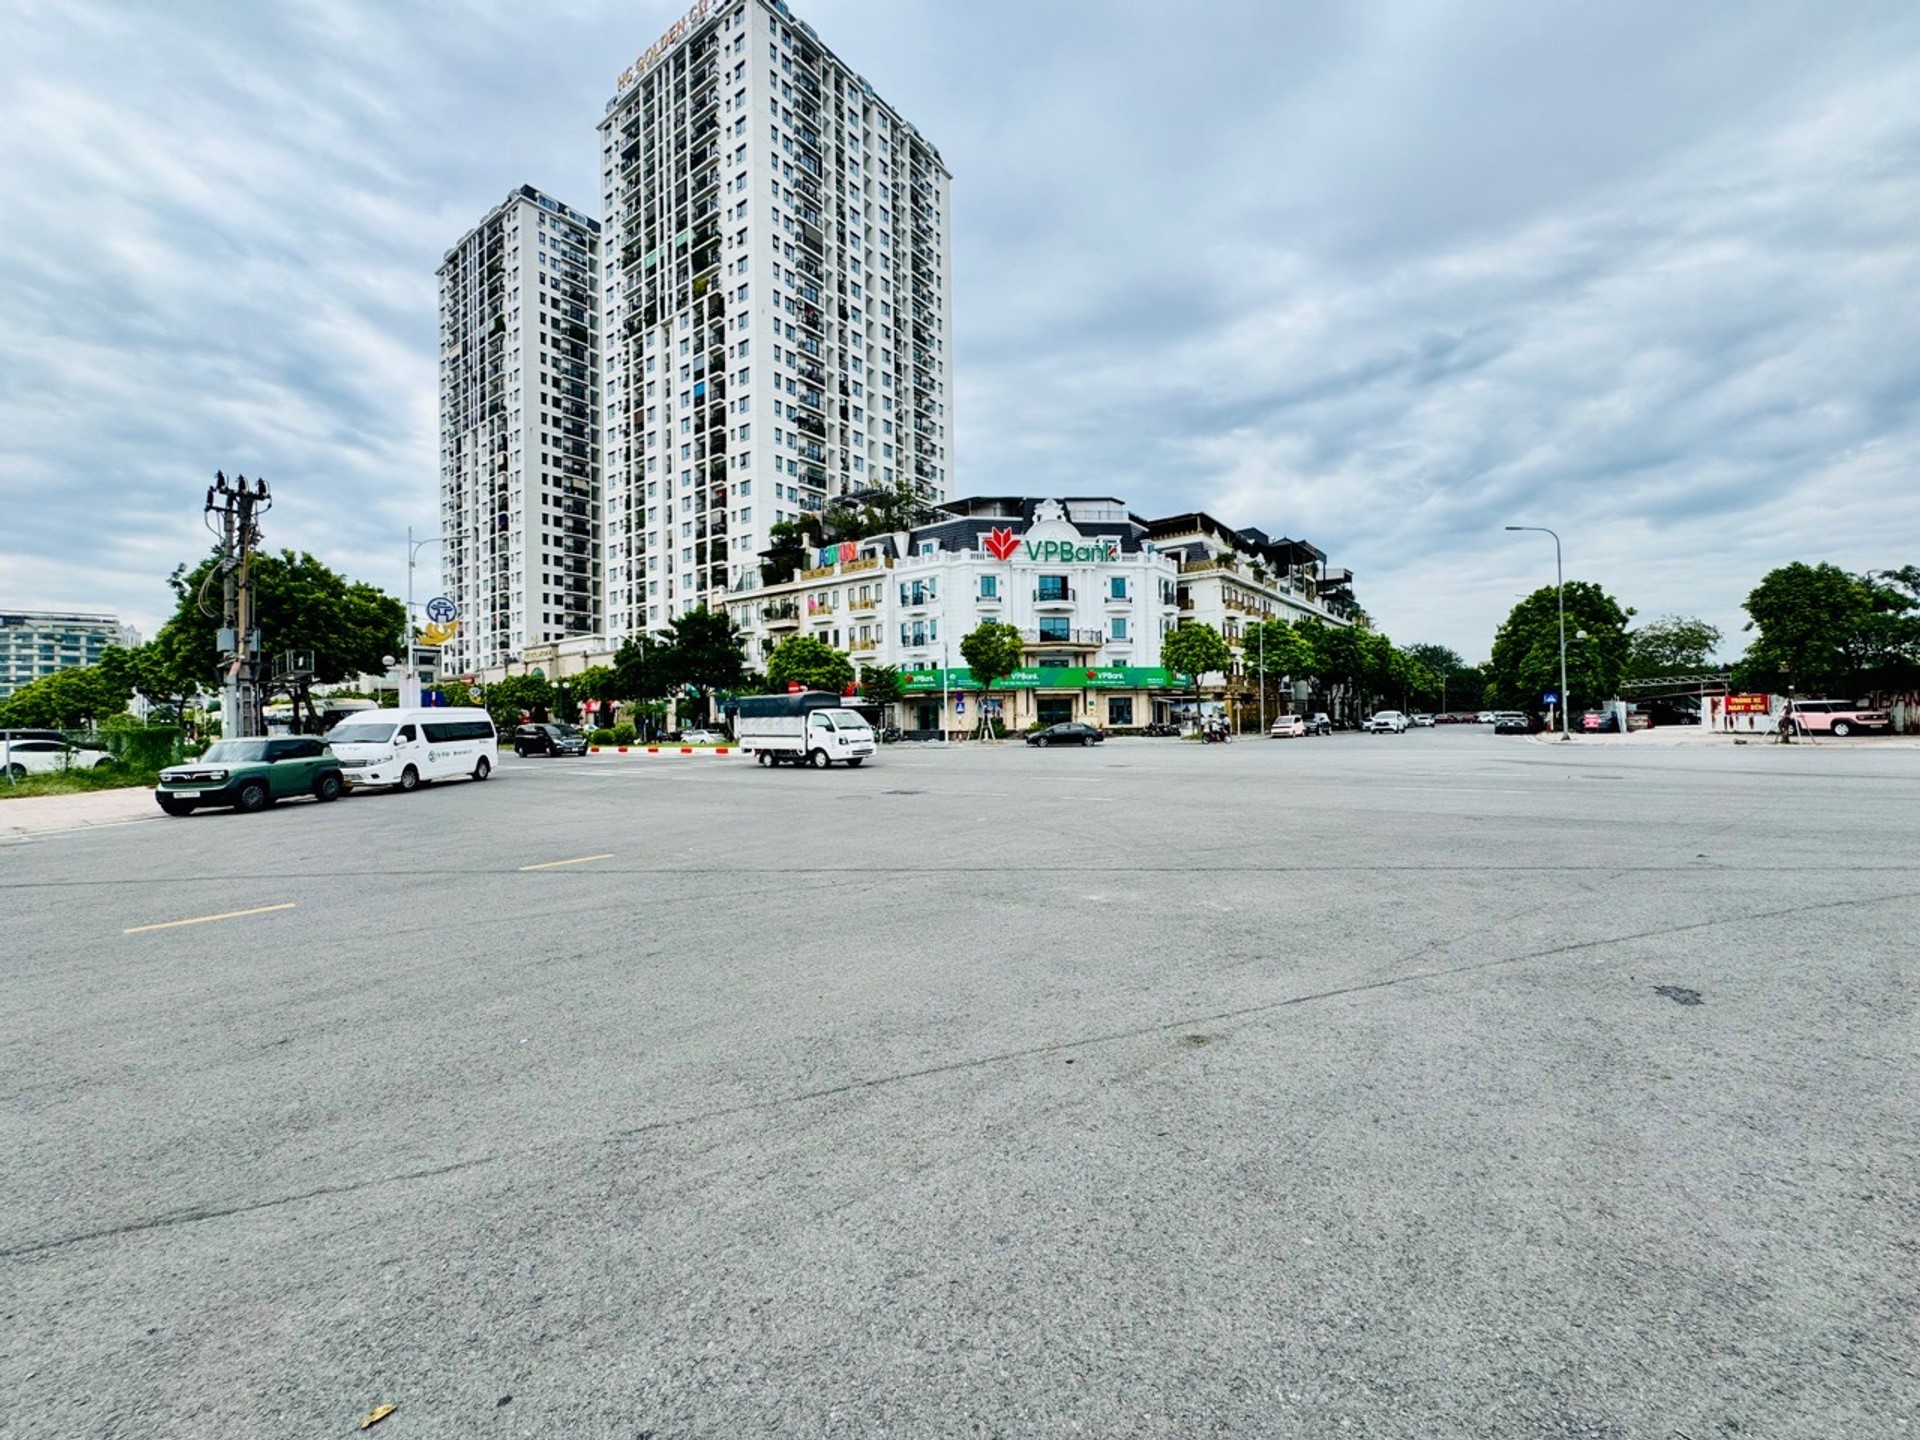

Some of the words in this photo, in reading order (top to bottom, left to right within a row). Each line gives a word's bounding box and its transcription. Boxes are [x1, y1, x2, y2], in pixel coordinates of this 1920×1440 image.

[636, 16, 686, 71] GOLDEN
[1025, 540, 1117, 562] VPBank
[1011, 672, 1039, 681] VPBank
[1097, 672, 1124, 680] VPBank
